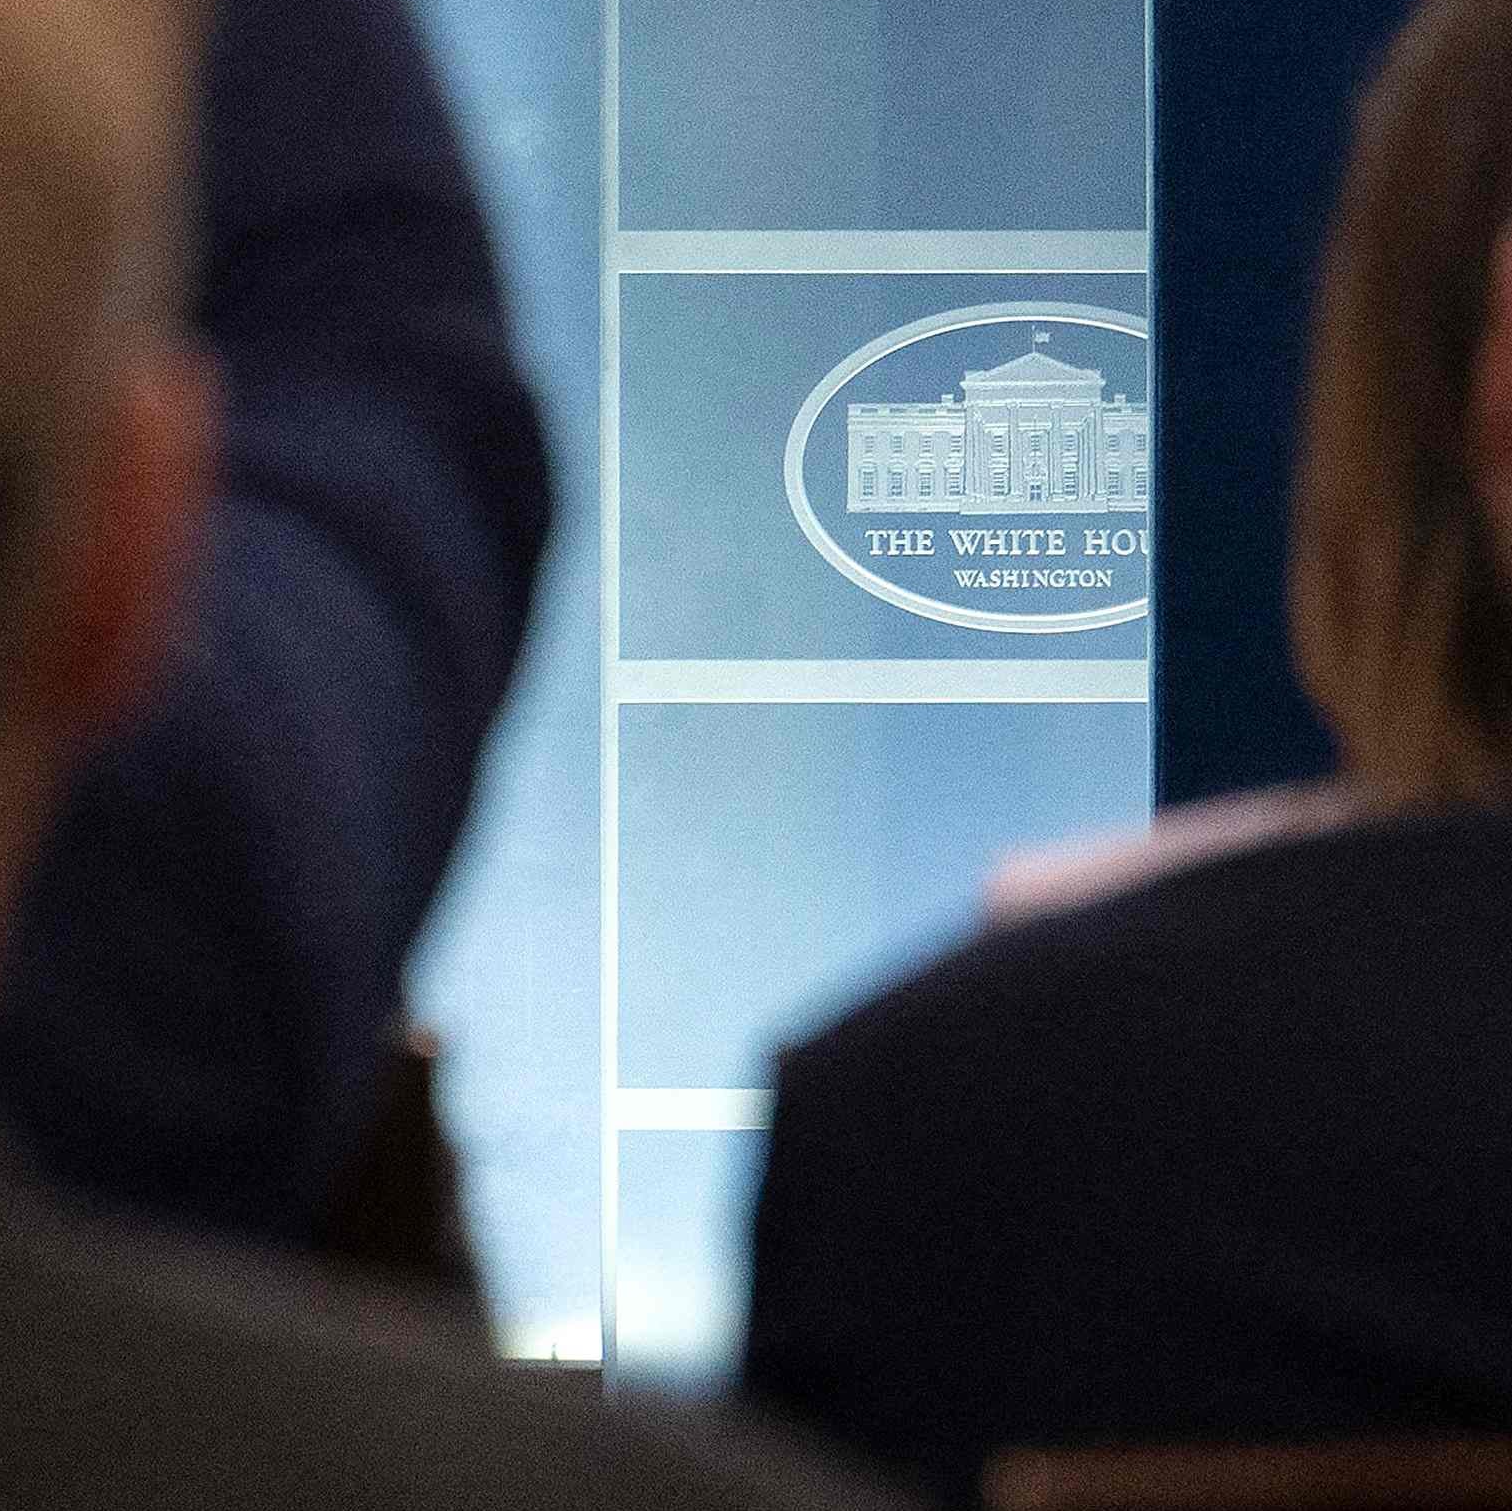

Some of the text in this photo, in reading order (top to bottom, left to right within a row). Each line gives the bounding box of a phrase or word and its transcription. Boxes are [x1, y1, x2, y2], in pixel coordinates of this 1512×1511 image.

[864, 529, 935, 556] THE
[948, 529, 1066, 556] WHITE
[953, 569, 1114, 589] WASHINGTON
